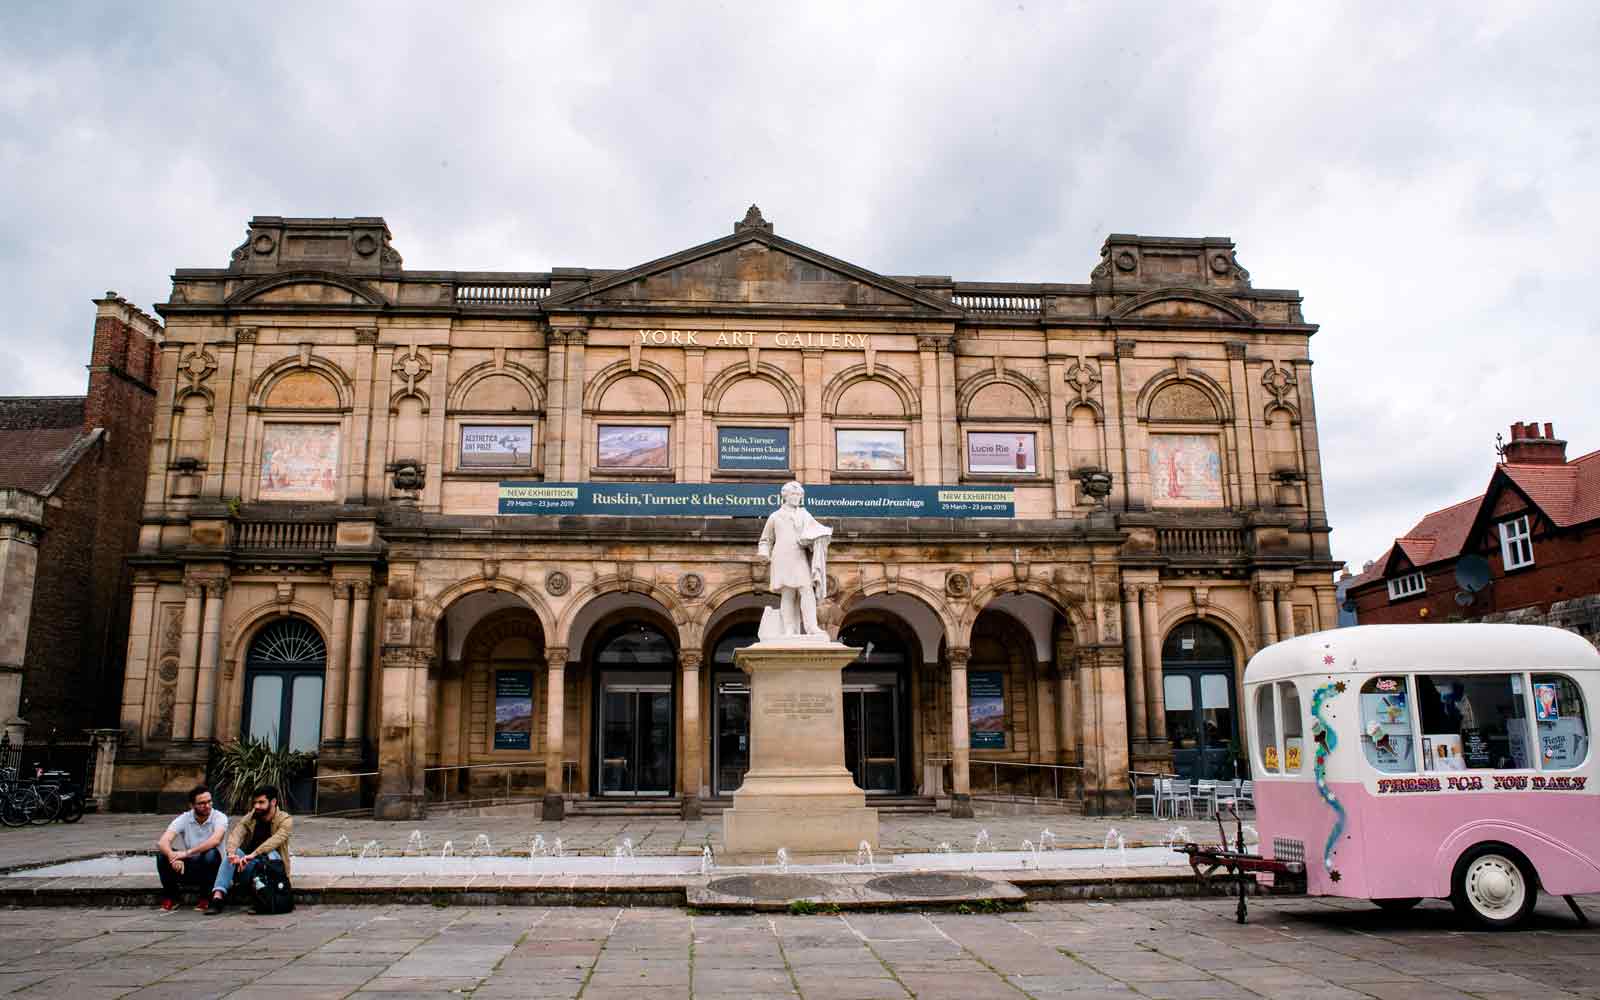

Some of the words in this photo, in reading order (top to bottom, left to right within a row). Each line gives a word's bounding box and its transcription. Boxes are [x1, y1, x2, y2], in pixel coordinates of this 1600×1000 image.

[639, 330, 699, 345] YORK
[715, 331, 759, 346] ART
[775, 332, 869, 348] GALLERY
[971, 442, 994, 453] Lucie
[995, 444, 1009, 453] Rie
[507, 489, 526, 497] NEW
[527, 489, 573, 497] EXHIBITION
[963, 493, 1007, 501] EXHIBITION
[546, 500, 559, 508] June
[592, 493, 641, 505] Ruskin,
[641, 494, 689, 505] Turner
[690, 494, 701, 505] &
[703, 494, 724, 506] the
[725, 494, 767, 506] Storm
[807, 497, 864, 507] Watercolours
[864, 498, 882, 507] and
[882, 498, 925, 509] Drawings
[1377, 776, 1442, 793] FRESH
[1447, 776, 1484, 791] FOR
[1492, 775, 1529, 791] YOU
[1530, 776, 1588, 791] DAILY
